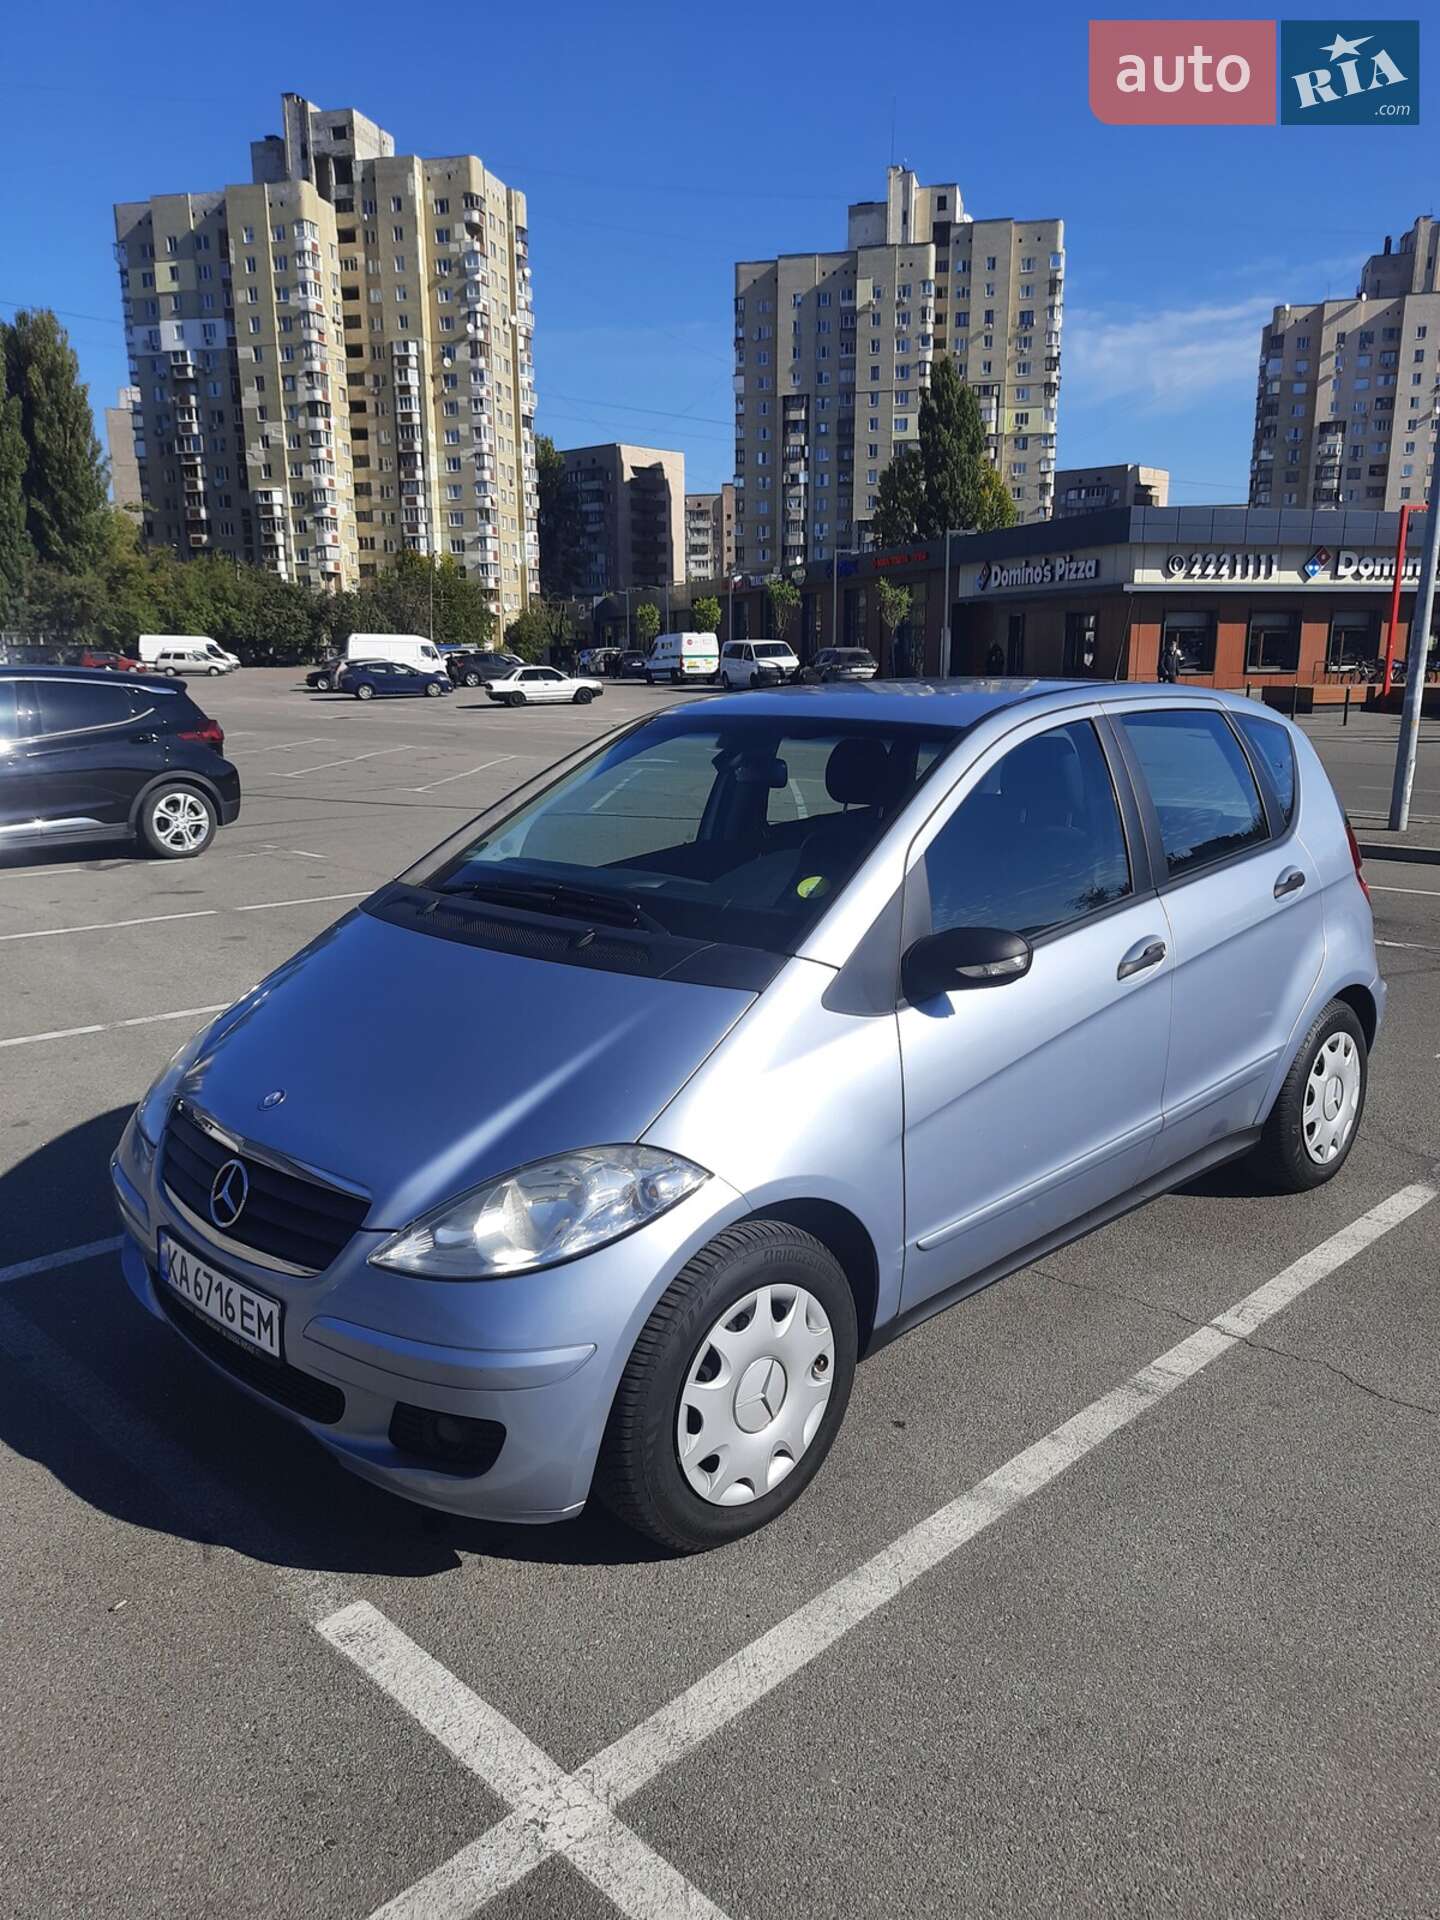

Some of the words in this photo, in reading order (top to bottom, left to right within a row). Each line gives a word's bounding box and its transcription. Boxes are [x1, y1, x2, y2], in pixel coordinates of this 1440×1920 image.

[991, 560, 1051, 588] Domino's
[1055, 555, 1097, 581] Pizza
[1190, 552, 1279, 578] 2221111
[194, 1267, 235, 1324] 6716
